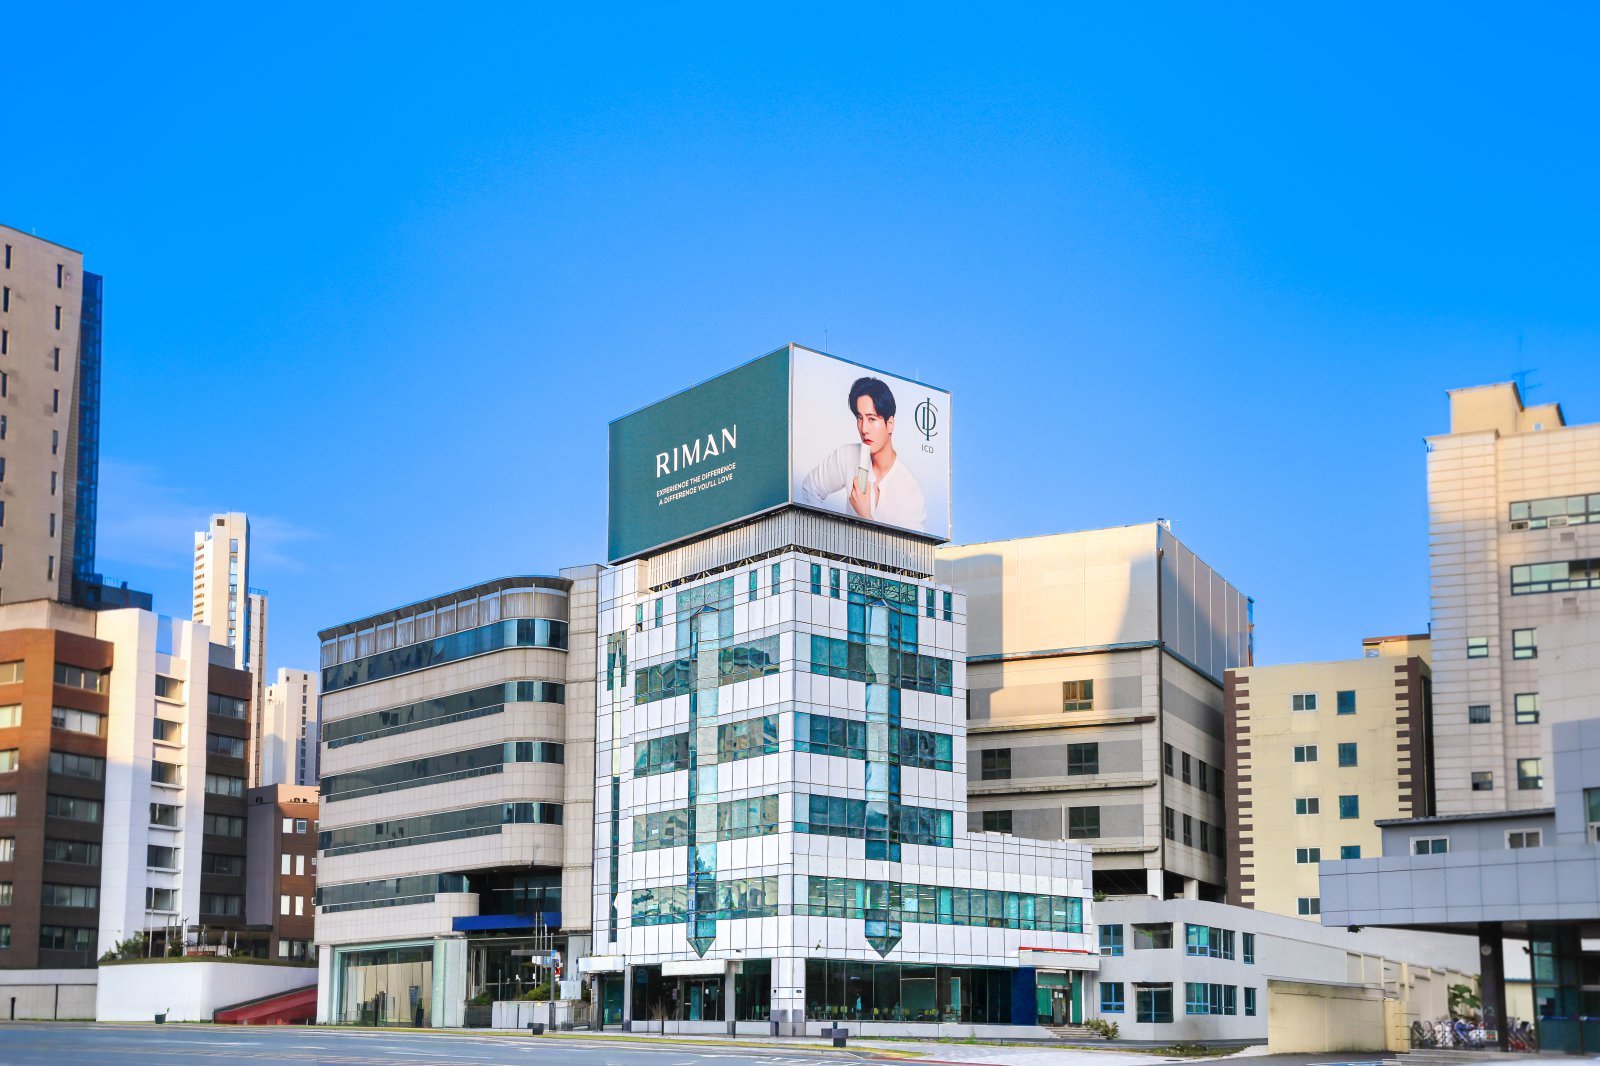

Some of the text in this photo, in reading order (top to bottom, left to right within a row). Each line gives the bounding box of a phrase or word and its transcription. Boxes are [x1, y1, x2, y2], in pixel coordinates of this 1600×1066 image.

[656, 424, 737, 479] RIMAN
[921, 444, 935, 454] ICD
[656, 462, 736, 498] EXPERIENCE THE DIFFERENCE
[664, 486, 697, 504] DIFFERENCE
[698, 480, 717, 492] YOU'LL
[717, 473, 733, 485] LOVE
